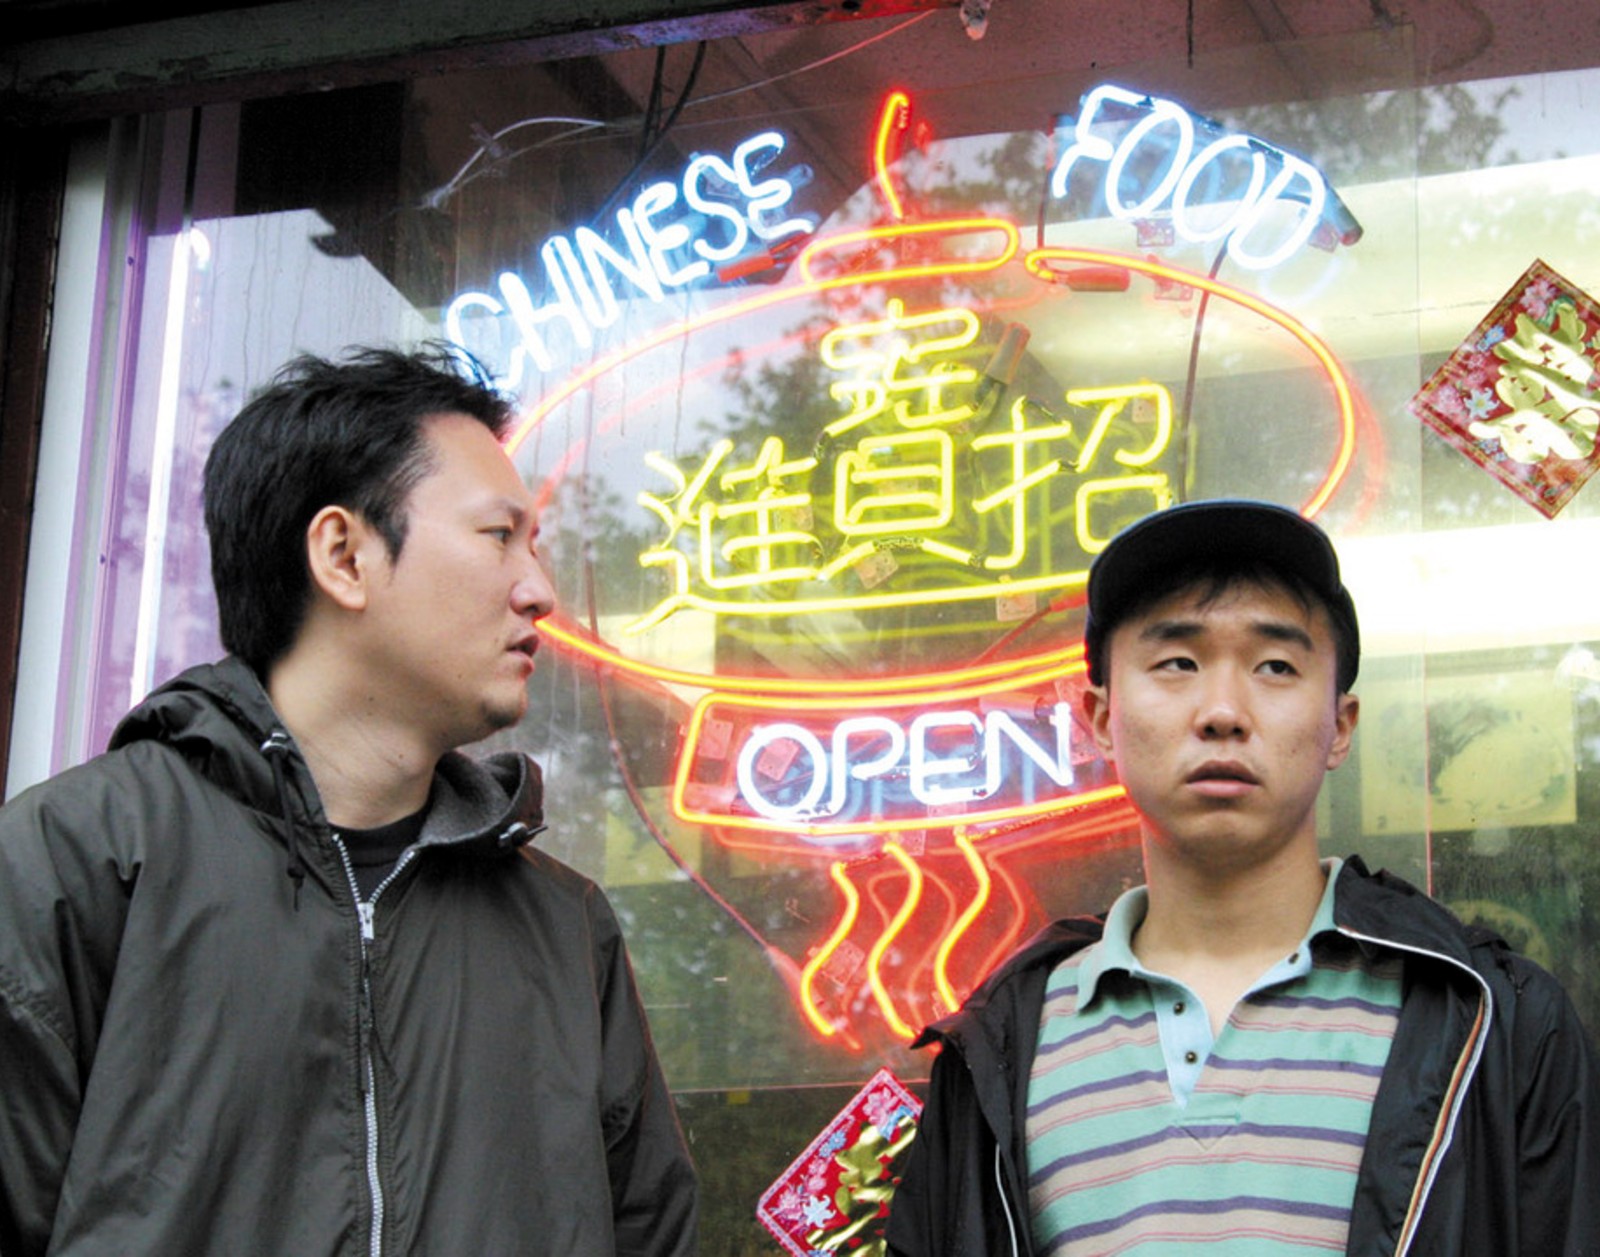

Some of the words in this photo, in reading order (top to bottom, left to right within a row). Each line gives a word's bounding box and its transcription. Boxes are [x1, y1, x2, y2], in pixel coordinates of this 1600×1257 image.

[446, 132, 813, 388] CHINESE
[1051, 85, 1326, 270] FOOD
[737, 701, 1074, 822] OPEN
